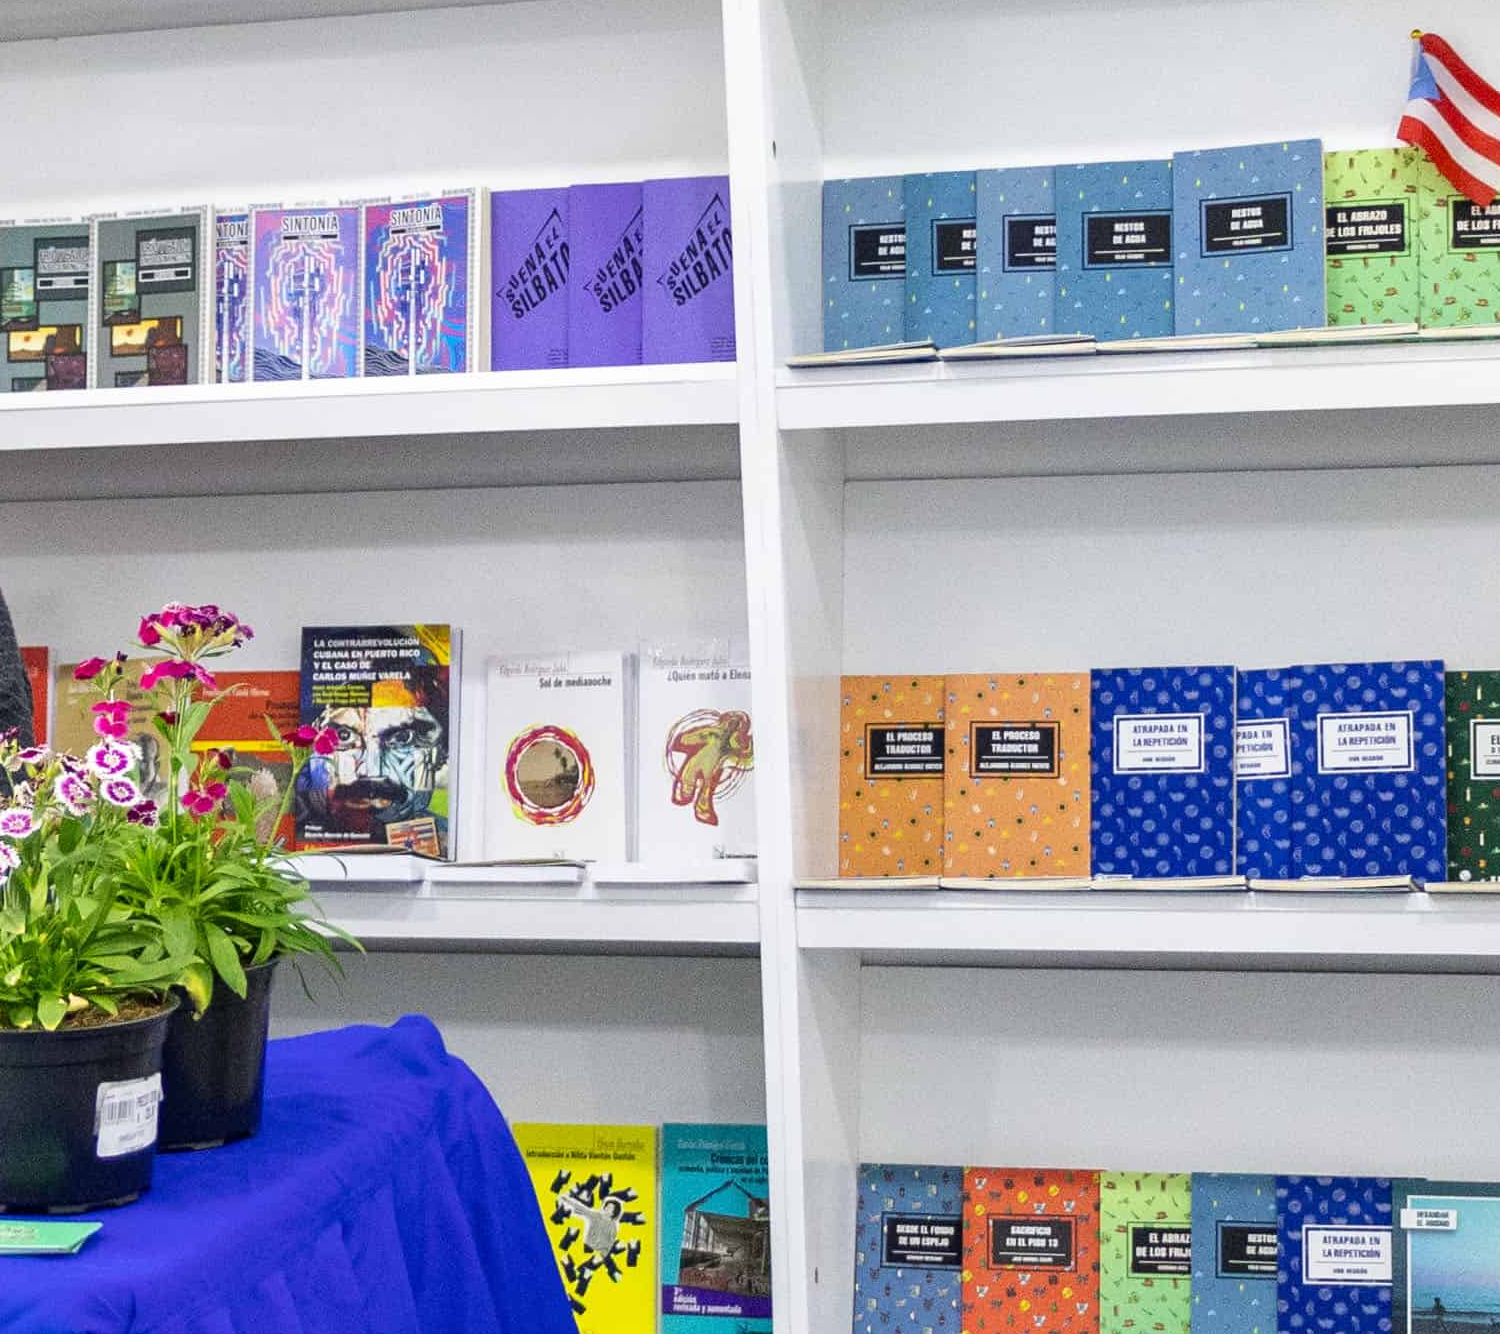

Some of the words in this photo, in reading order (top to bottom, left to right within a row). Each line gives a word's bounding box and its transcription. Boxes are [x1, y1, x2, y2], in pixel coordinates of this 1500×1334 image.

[391, 203, 442, 226] SINTONÍA
[1336, 213, 1348, 223] EL
[282, 212, 338, 232] SINTONÍA
[666, 227, 708, 290] SUENA
[505, 242, 546, 304] SUENA
[365, 649, 398, 658] PUERTO
[539, 677, 552, 689] Sol
[553, 678, 563, 688] de
[565, 676, 612, 688] medianoche
[1132, 724, 1175, 734] ATRAPADA
[1177, 723, 1188, 734] EN
[1337, 722, 1383, 734] ATRAPADA
[1385, 721, 1397, 733] EN
[886, 731, 895, 742] EL
[992, 730, 1002, 740] EL
[1262, 729, 1273, 739] EN
[1490, 735, 1500, 745] EL
[1132, 736, 1142, 747] LA
[1143, 735, 1188, 747] REPETICIÓN
[1338, 736, 1348, 747] LA
[1349, 734, 1397, 746] REPETICIÓN
[1322, 1235, 1366, 1246] ATRAPADA
[1368, 1235, 1381, 1246] EN
[1322, 1248, 1333, 1259] LA
[1333, 1247, 1381, 1259] REPETICIÓN
